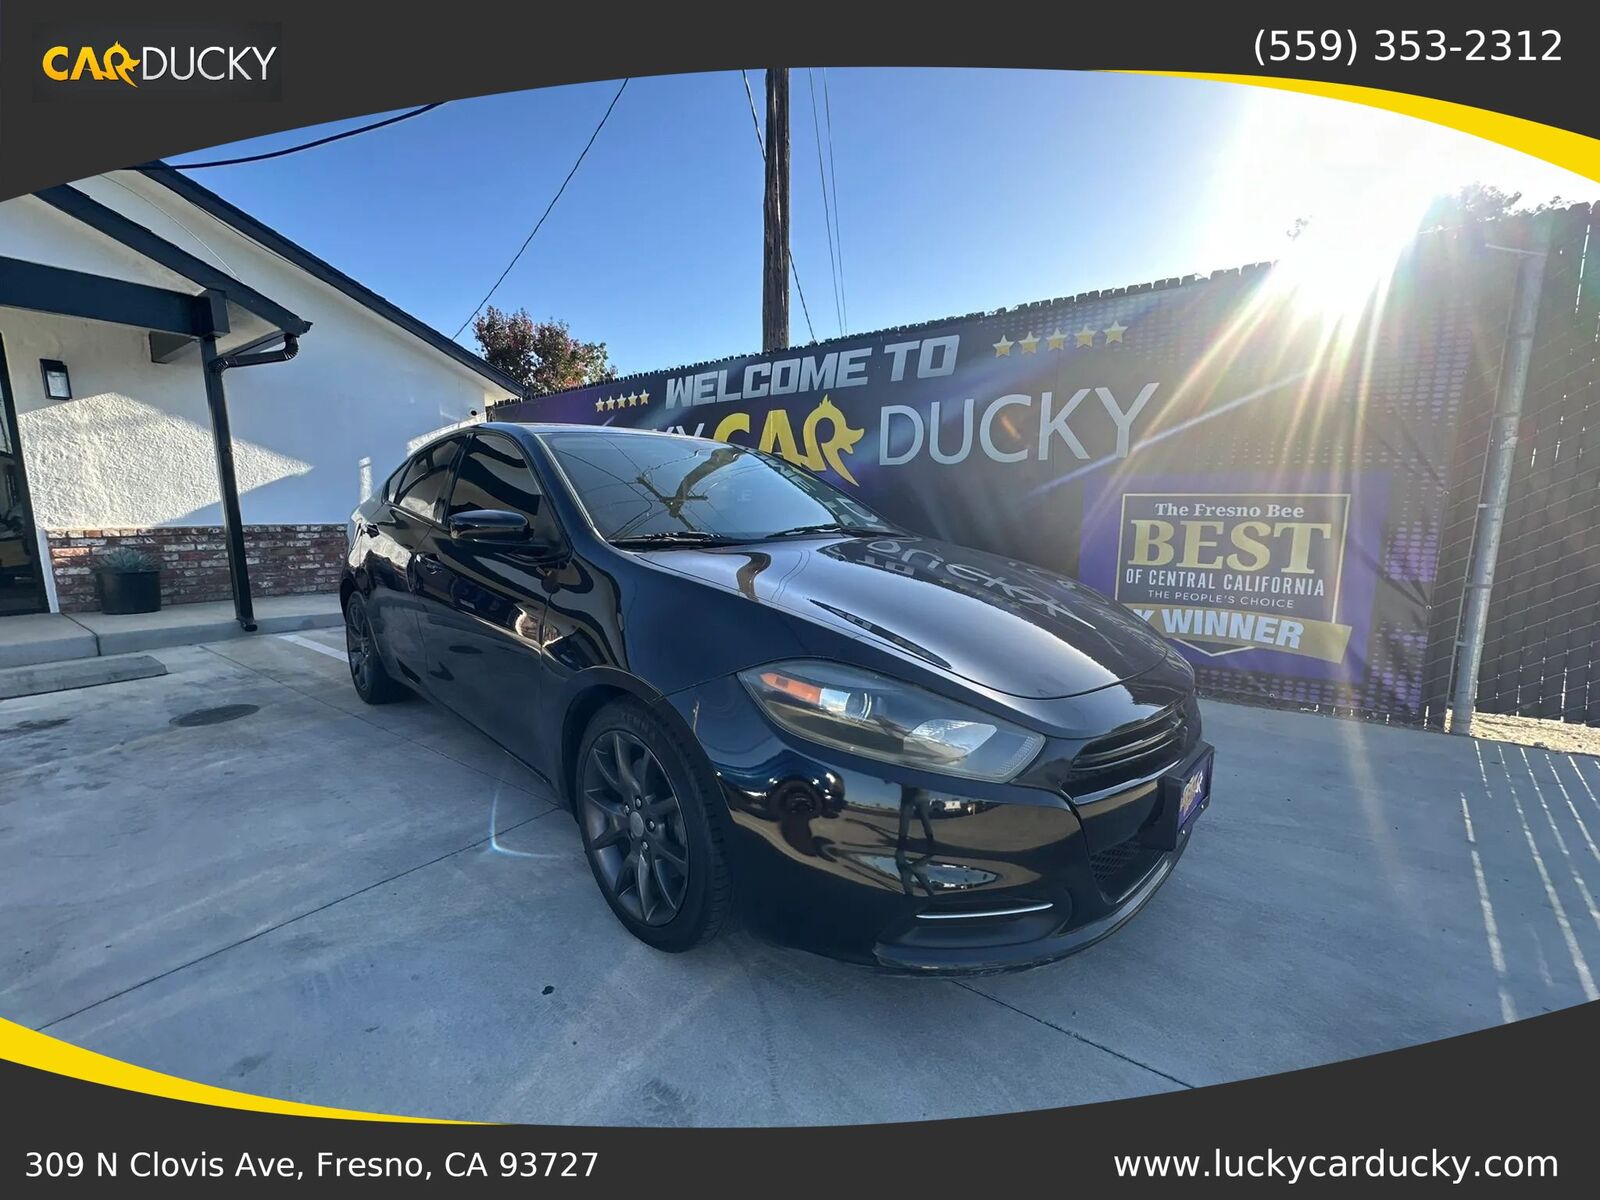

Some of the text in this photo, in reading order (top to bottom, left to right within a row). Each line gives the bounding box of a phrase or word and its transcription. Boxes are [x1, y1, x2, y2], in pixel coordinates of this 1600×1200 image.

[665, 334, 960, 409] WELCOME TO
[879, 382, 1160, 466] DUCKY
[1154, 503, 1305, 518] The Fresno Bee
[1127, 519, 1332, 574] BEST
[1126, 568, 1143, 584] OF
[1148, 569, 1217, 590] CENTRAL
[1223, 573, 1325, 597] CALIFORNIA
[1149, 589, 1295, 608] THE PEOPLE'S CHOICE
[1161, 608, 1305, 650] WINNER
